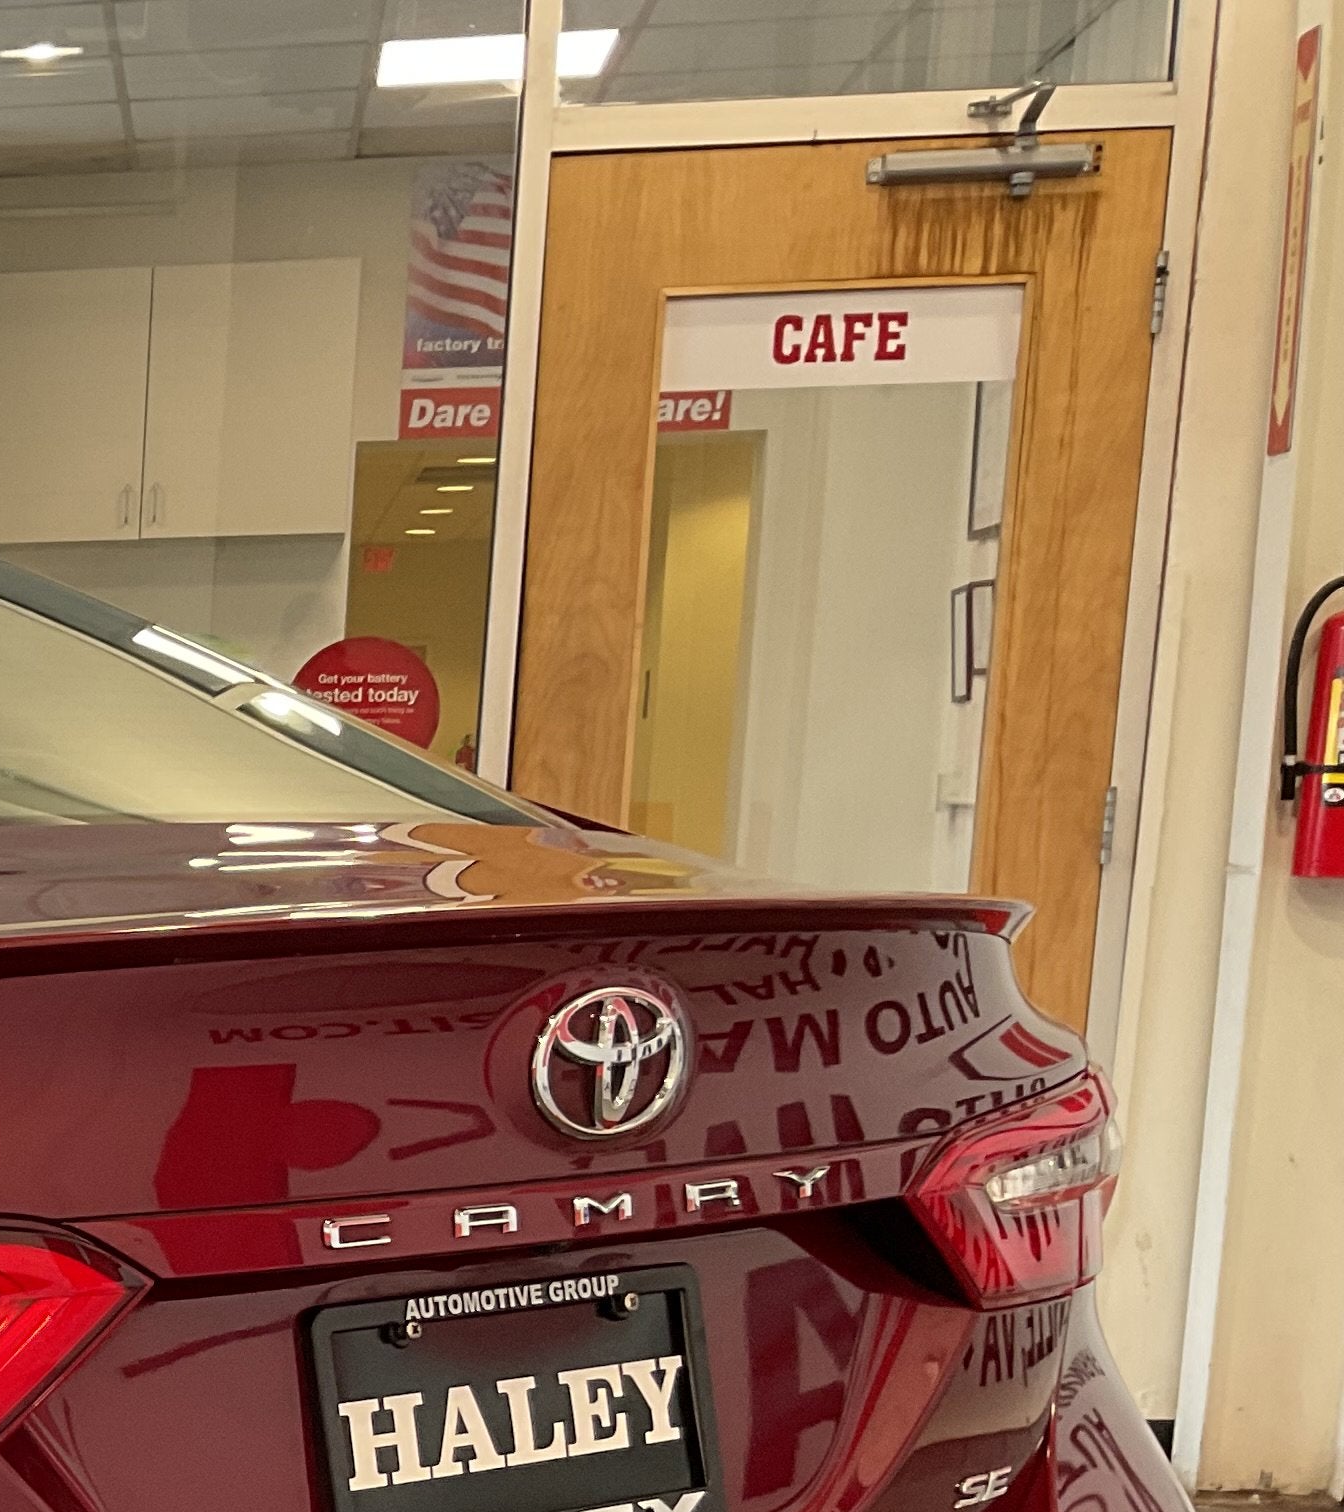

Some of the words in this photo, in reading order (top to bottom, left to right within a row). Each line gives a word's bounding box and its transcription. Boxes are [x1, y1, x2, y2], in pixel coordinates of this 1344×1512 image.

[416, 337, 482, 354] factory
[772, 312, 909, 365] CAFE
[408, 398, 492, 429] Dare
[318, 673, 338, 684] Get
[340, 675, 365, 686] your
[367, 673, 408, 685] battery
[367, 686, 419, 705] today
[321, 1164, 831, 1250] CAMRY
[405, 1283, 543, 1322] AUTOMOTIVE
[549, 1274, 620, 1302] GROUP
[337, 1354, 683, 1492] HALEY
[953, 1465, 1012, 1509] SE
